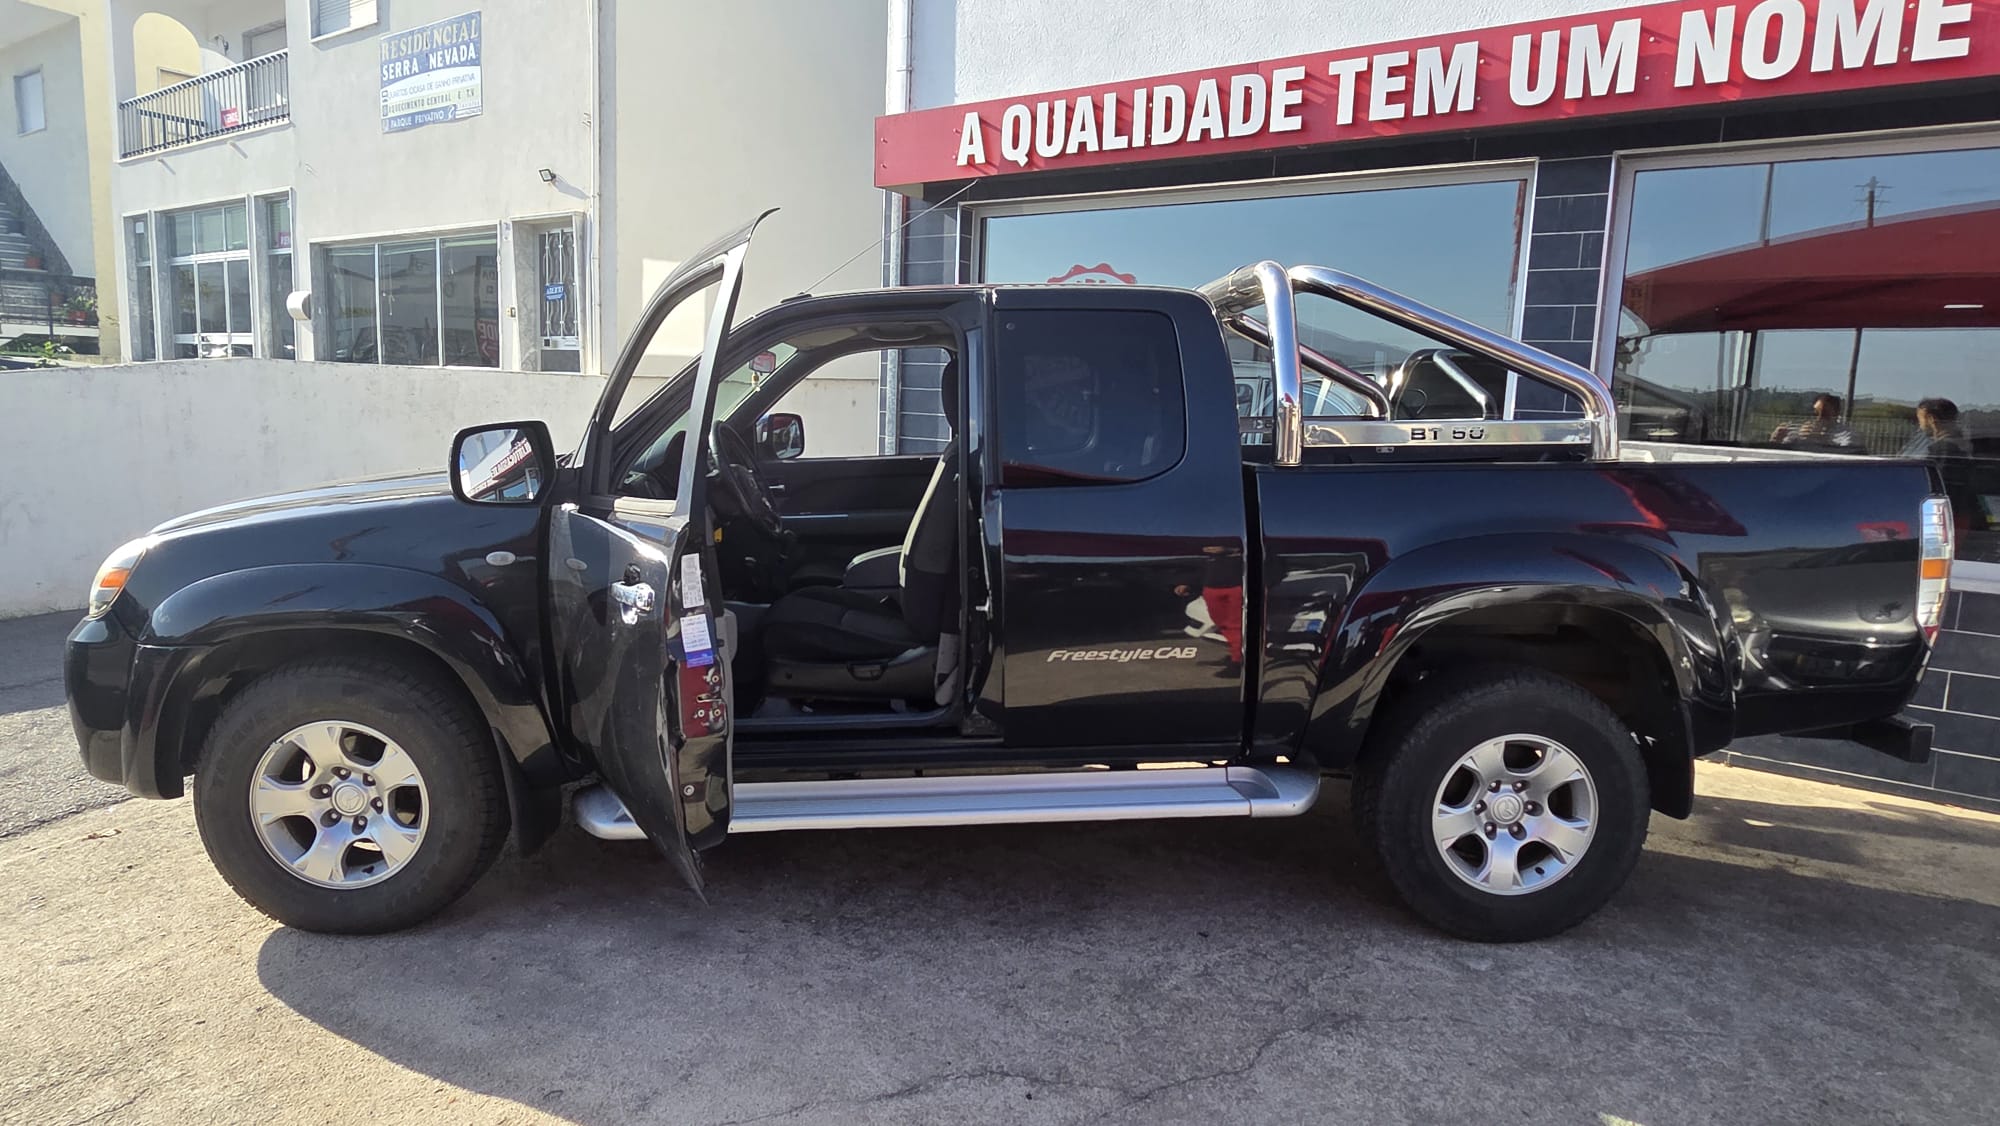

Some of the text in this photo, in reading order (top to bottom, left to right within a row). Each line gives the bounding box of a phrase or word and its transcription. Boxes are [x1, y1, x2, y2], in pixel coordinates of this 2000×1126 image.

[381, 18, 479, 61] RESIDENCIAL
[382, 42, 476, 81] SERRA NEVADA
[957, 0, 1974, 168] A QUALIDADE TEM UM NOME
[1410, 426, 1484, 440] BT 50
[1046, 646, 1198, 663] FreestyleCAB
